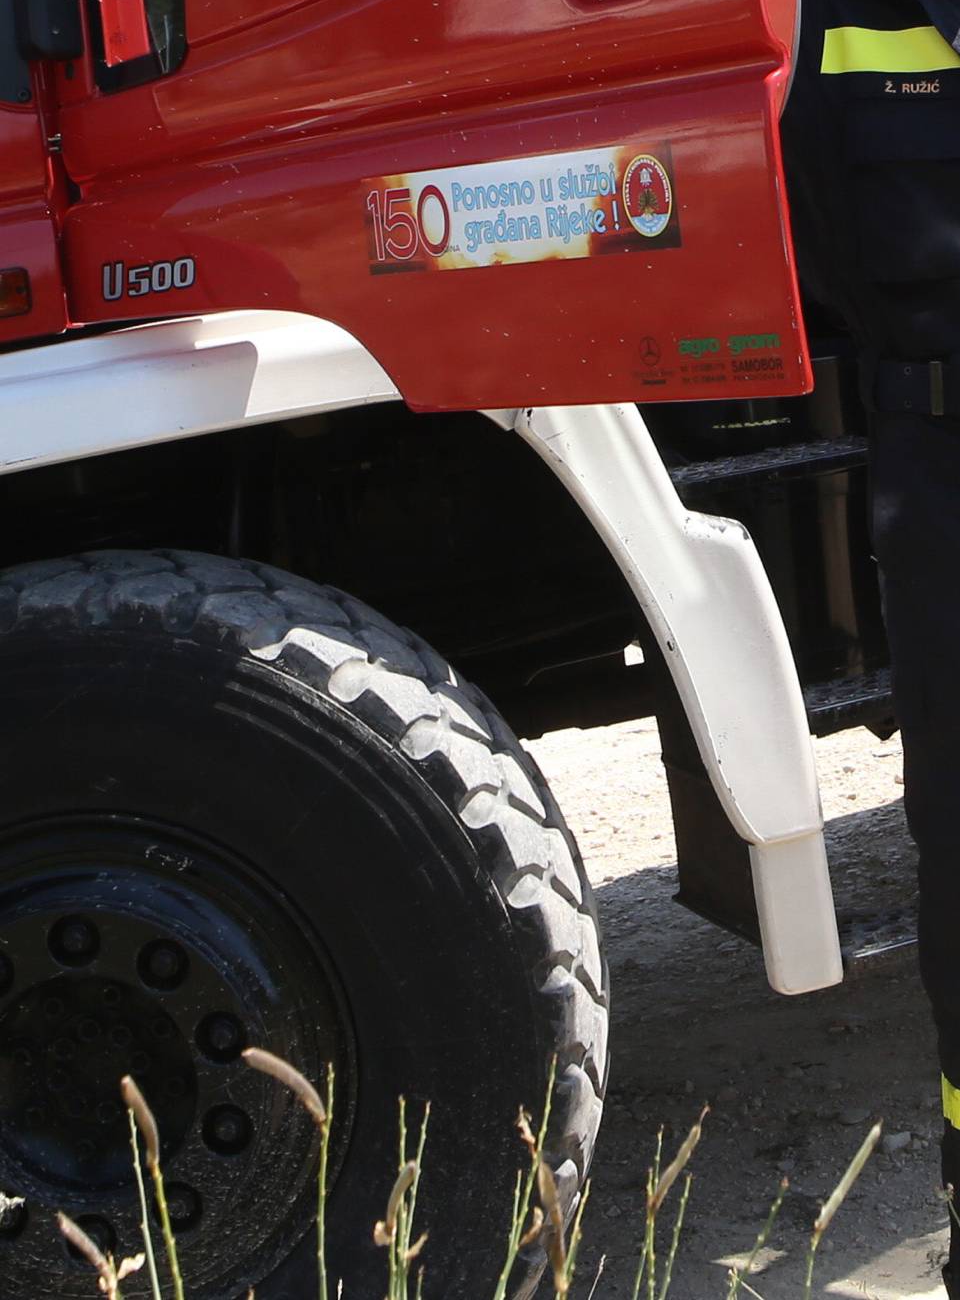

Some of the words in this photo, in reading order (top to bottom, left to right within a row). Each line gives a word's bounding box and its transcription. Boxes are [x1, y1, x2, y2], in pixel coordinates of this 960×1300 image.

[901, 78, 940, 94] RUŽIĆ
[451, 181, 535, 213] Ponosno
[539, 177, 553, 203] u
[558, 161, 617, 199] službi
[365, 183, 451, 263] 150
[463, 209, 541, 254] građana
[544, 202, 607, 245] Rijeke
[730, 356, 784, 374] SAMOBOR
